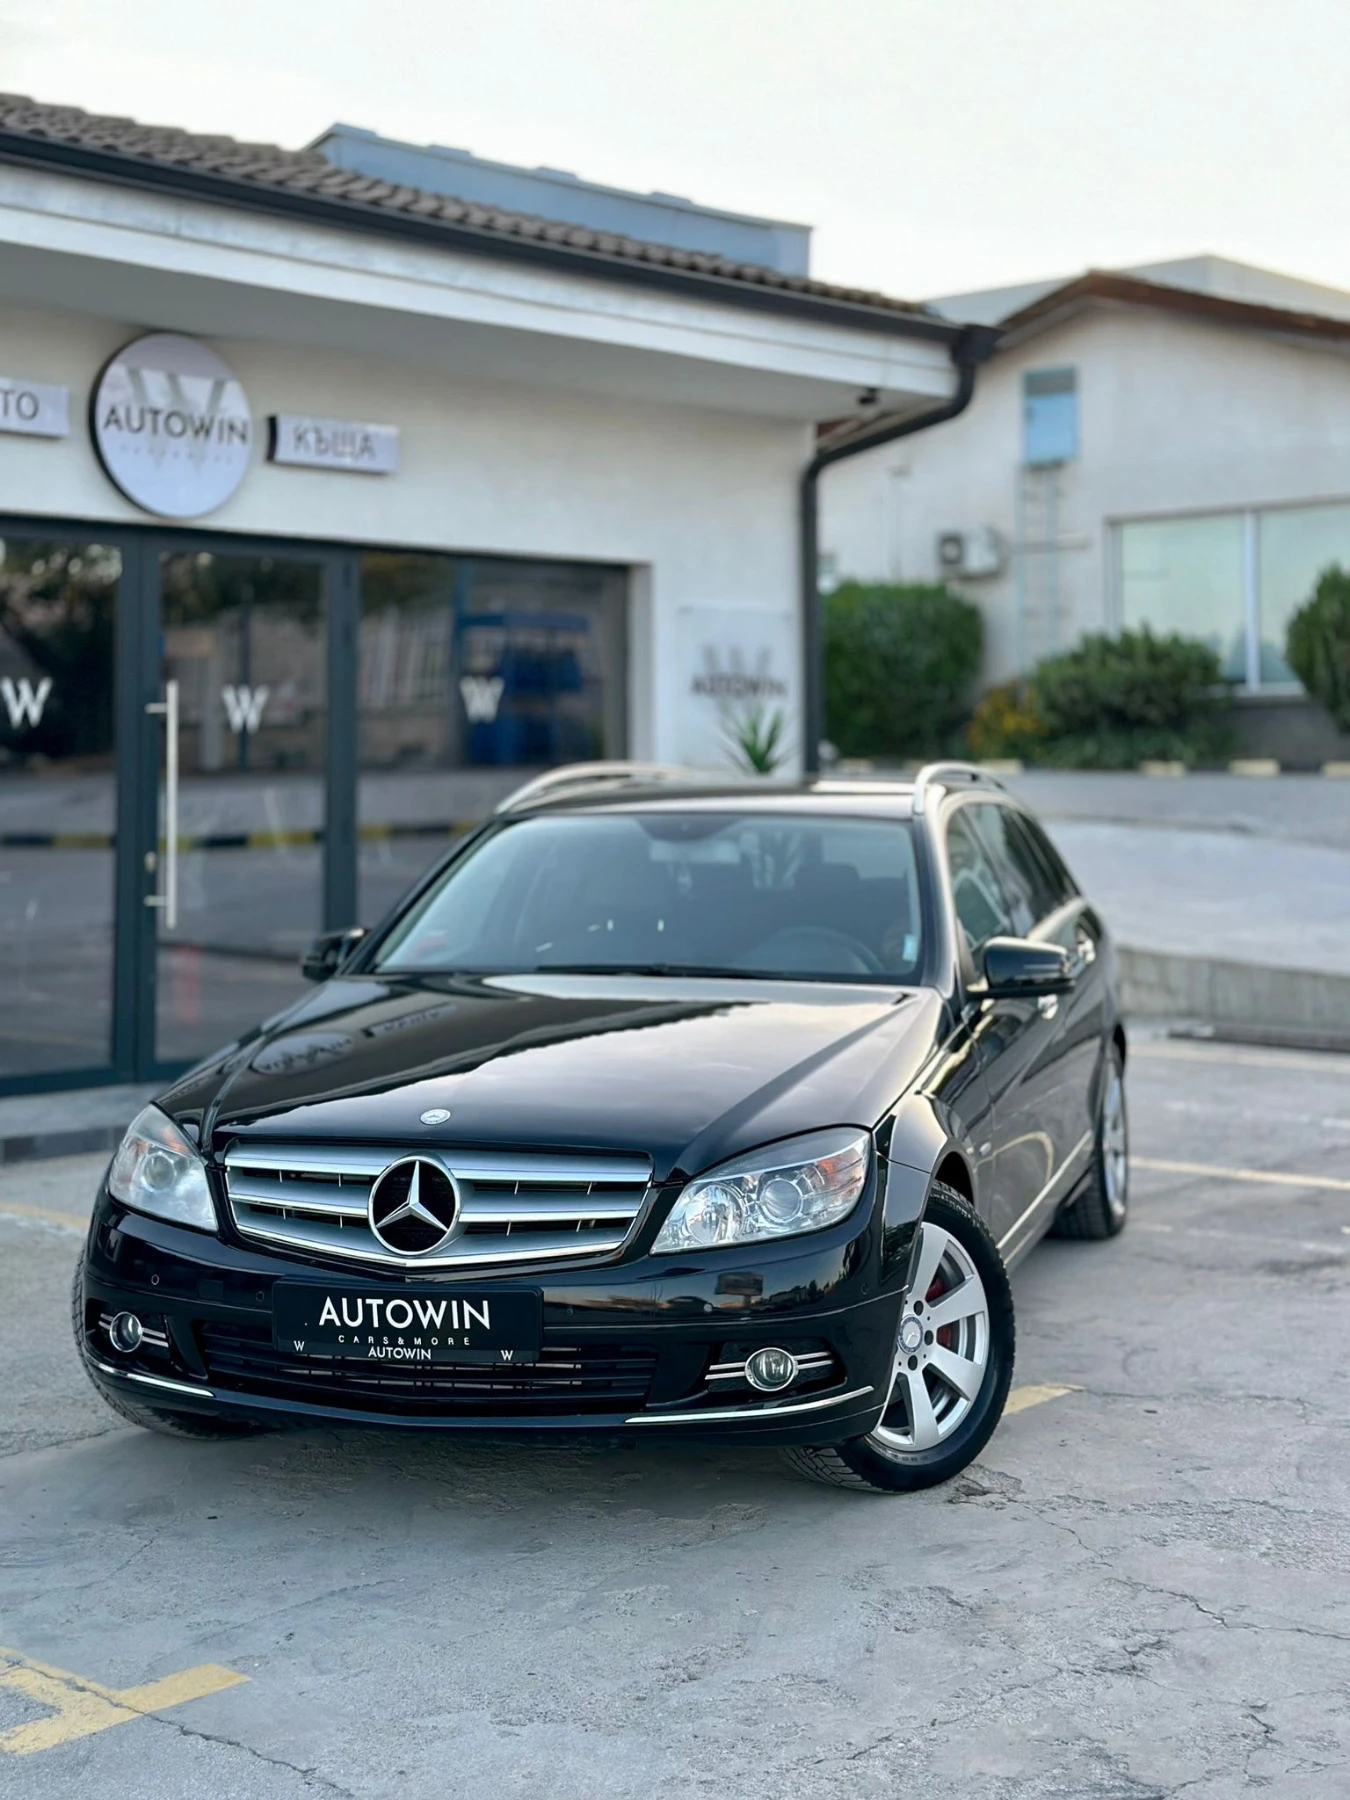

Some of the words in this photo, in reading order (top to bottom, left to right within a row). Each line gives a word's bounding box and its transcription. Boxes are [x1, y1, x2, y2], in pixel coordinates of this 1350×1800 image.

[103, 403, 249, 446] AUTOWIN
[293, 425, 377, 462] КЪЩА
[2, 677, 52, 728] W
[223, 685, 269, 732] W
[460, 677, 504, 722] W
[319, 1296, 490, 1330] AUTOWIN
[293, 1340, 305, 1352] W
[368, 1347, 431, 1360] AUTOWIN
[501, 1350, 513, 1361] W
